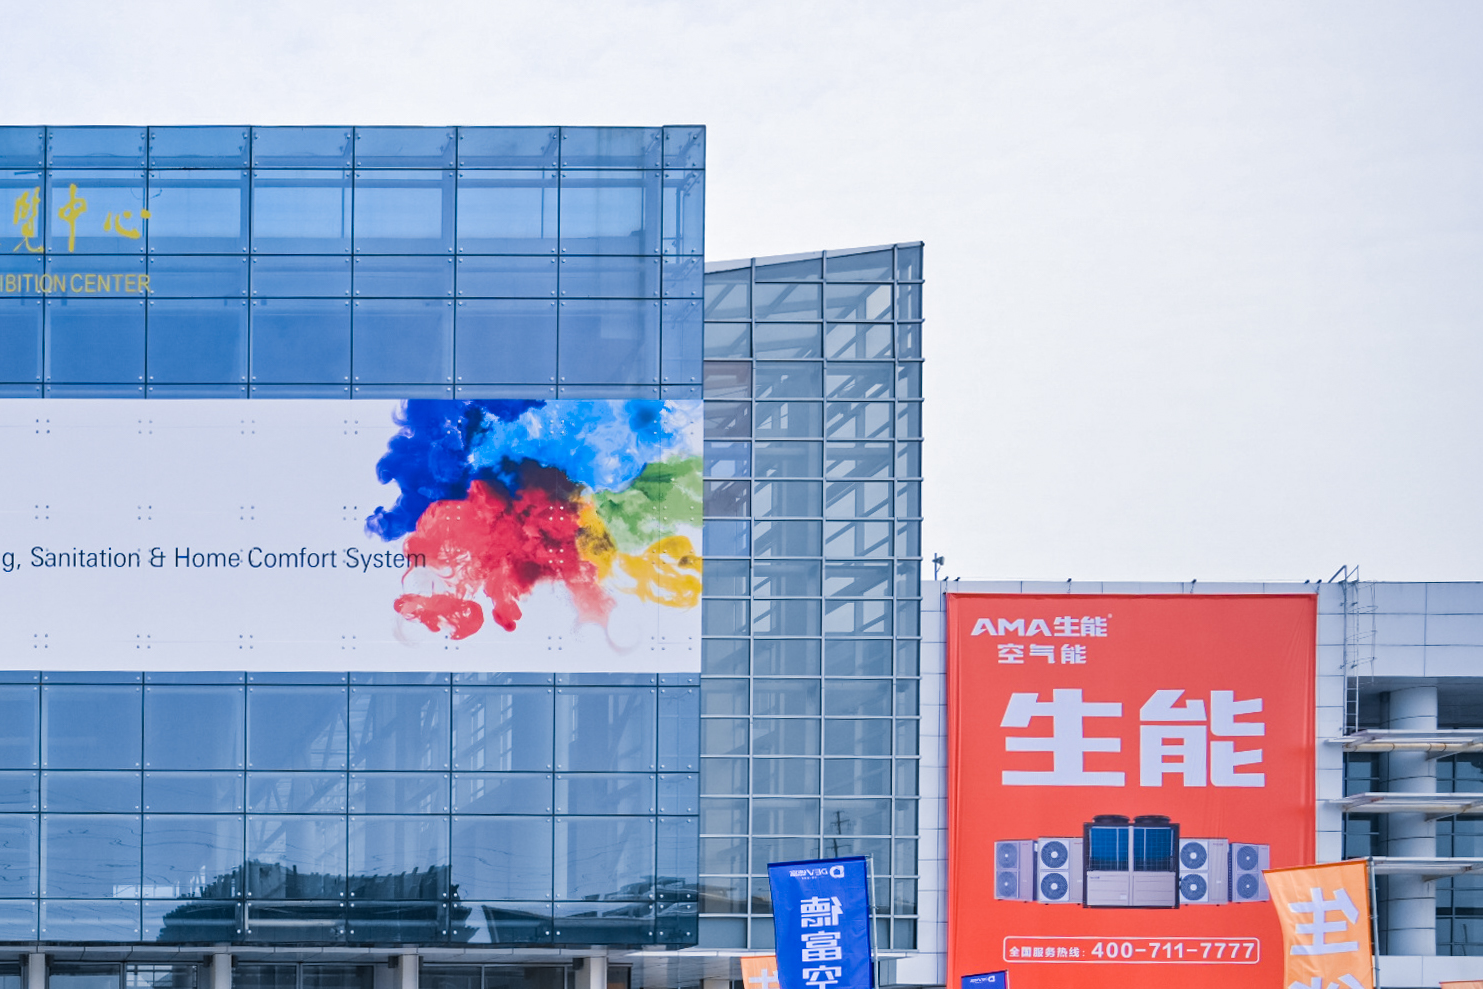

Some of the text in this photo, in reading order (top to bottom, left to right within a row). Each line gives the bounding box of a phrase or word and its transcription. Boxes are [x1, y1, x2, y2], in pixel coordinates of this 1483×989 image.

[70, 273, 152, 293] CENTER
[30, 546, 140, 568] Sanitation
[149, 547, 166, 568] &
[175, 547, 243, 568] Home
[248, 546, 337, 569] Comfort
[346, 546, 426, 573] System
[997, 643, 1087, 665] 空气能
[999, 688, 1266, 788] 生能
[1090, 941, 1256, 959] 400-711-7777
